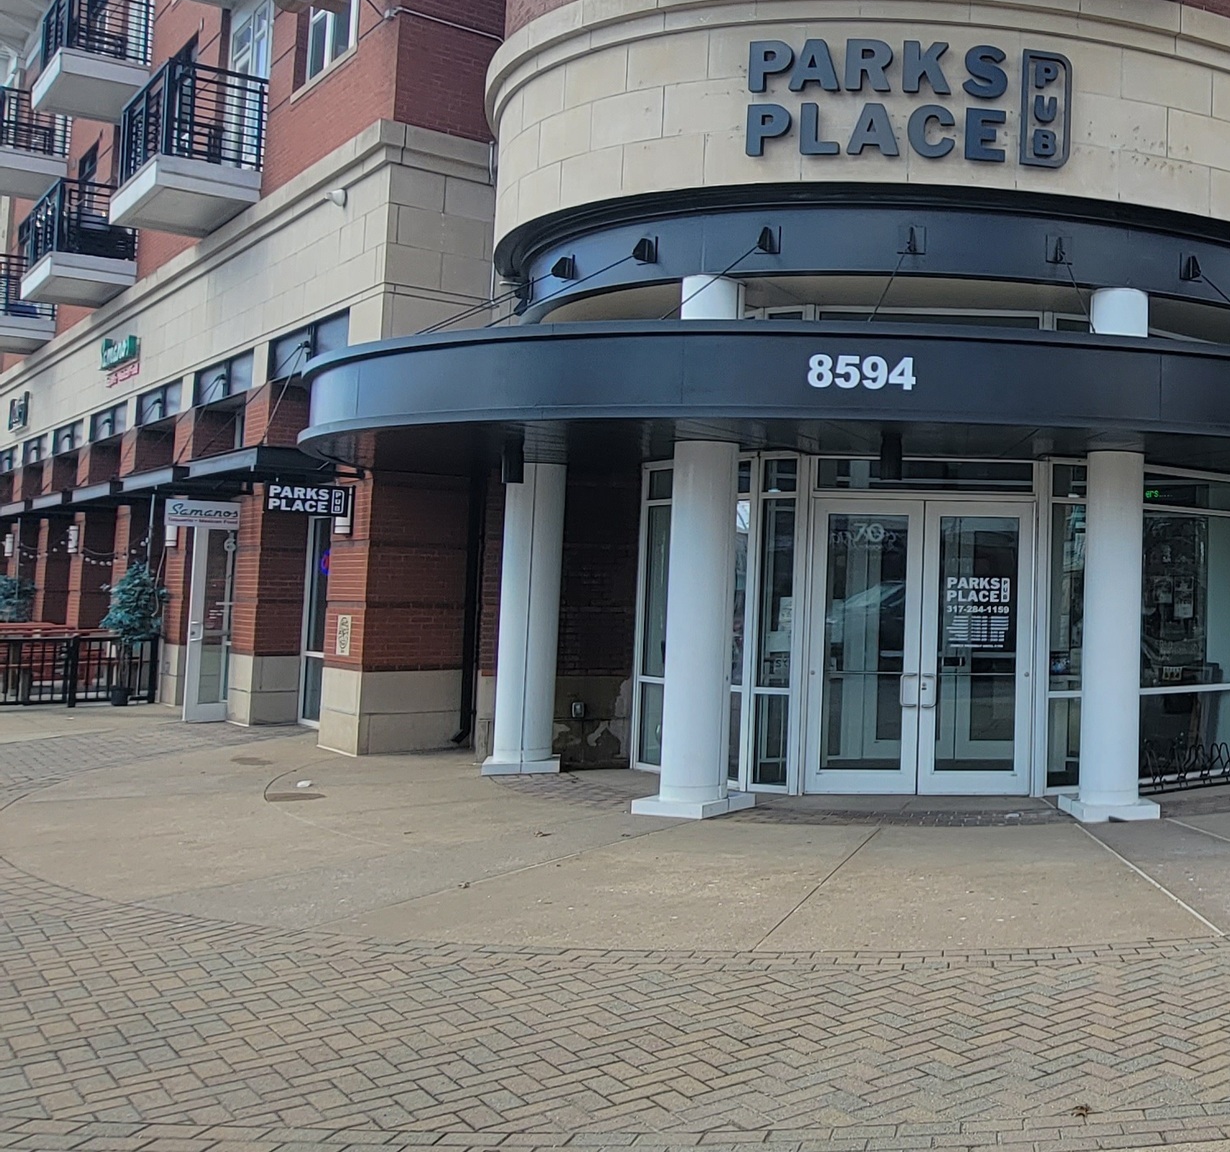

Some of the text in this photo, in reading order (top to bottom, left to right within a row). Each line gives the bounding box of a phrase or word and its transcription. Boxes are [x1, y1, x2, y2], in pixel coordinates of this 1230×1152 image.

[747, 38, 1010, 100] PARKS
[1033, 61, 1059, 158] PUB
[745, 102, 1008, 164] PLACE
[807, 353, 918, 391] 8594
[268, 484, 330, 501] PARKS
[167, 502, 239, 518] Samanos
[267, 498, 329, 513] PLACE
[946, 576, 1001, 590] PARKS
[946, 590, 1000, 603] PLACE
[946, 605, 1010, 614] 317-284-1159
